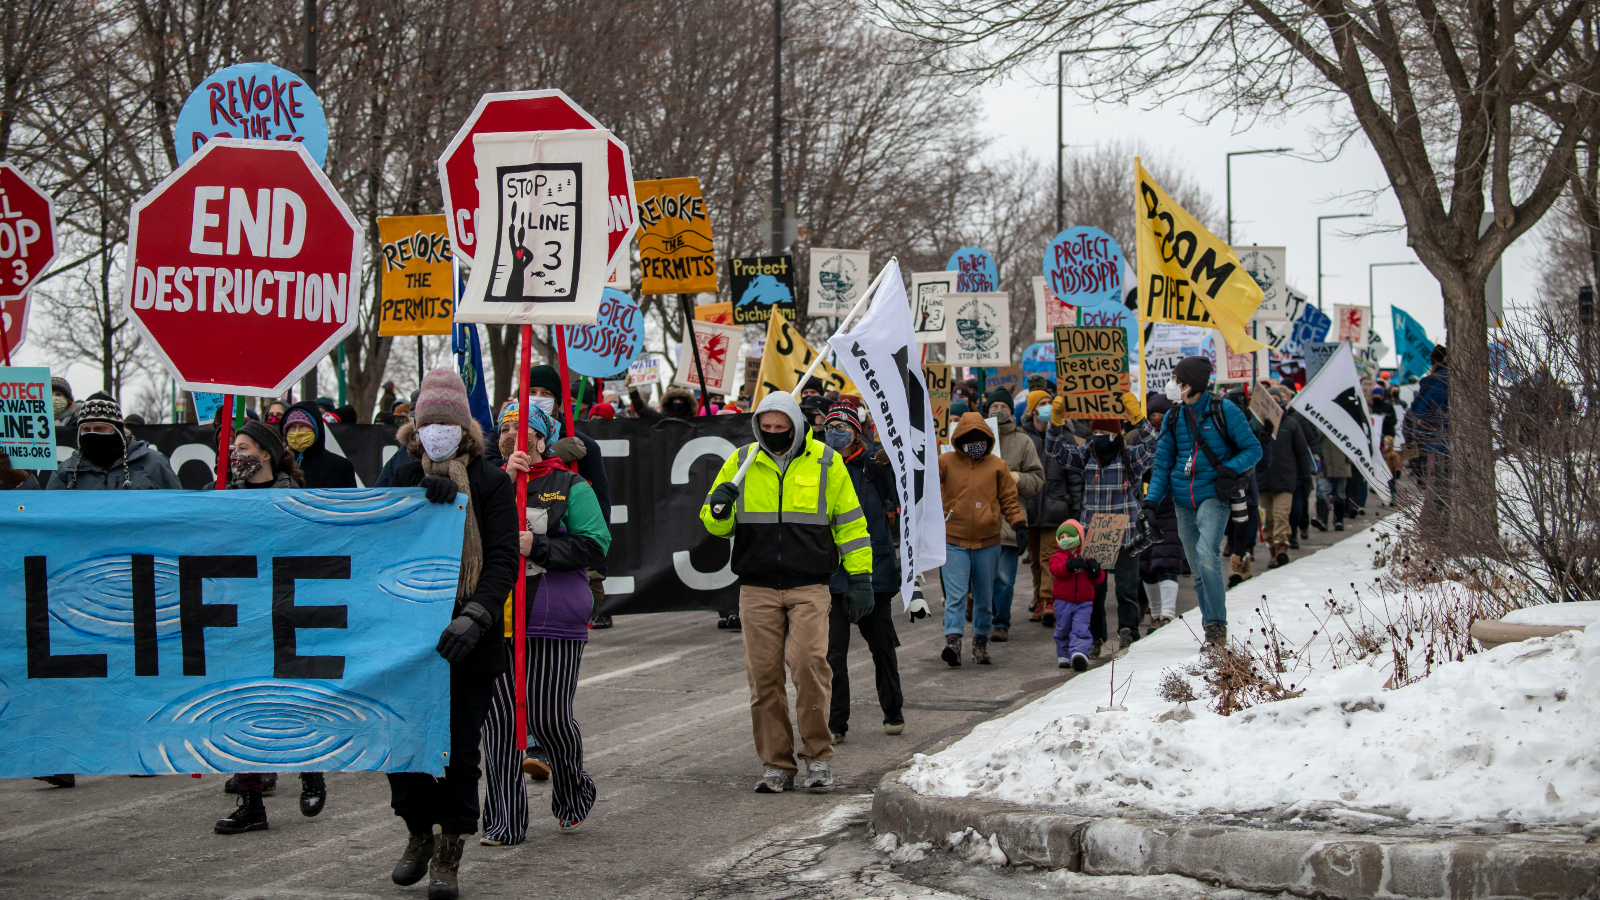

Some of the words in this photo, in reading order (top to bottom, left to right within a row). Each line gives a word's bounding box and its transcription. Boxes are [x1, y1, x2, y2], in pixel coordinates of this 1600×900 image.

[206, 75, 305, 134] REVOKE
[239, 113, 272, 141] THE
[507, 175, 547, 199] STOP
[190, 186, 307, 259] END
[528, 212, 570, 231] LINE
[637, 193, 706, 233] REVOKE
[382, 230, 453, 273] REVOKE
[662, 235, 684, 251] THE
[1053, 233, 1109, 270] PROTECT
[542, 241, 562, 270] 3
[641, 255, 715, 280] PERMITS
[733, 257, 788, 276] Protect
[957, 253, 987, 273] PROTECT
[11, 259, 29, 286] 3
[405, 272, 432, 288] THE
[133, 266, 347, 323] DESTRUCTION
[920, 285, 938, 296] STOP
[1147, 274, 1210, 324] PIPEL
[382, 296, 453, 321] PERMITS
[598, 298, 638, 333] OTECT
[932, 309, 941, 321] 3
[957, 300, 979, 316] PROTECT
[1271, 303, 1277, 311] 3
[1056, 329, 1125, 354] HONOR
[630, 358, 658, 370] WATER
[958, 352, 975, 360] STOP
[976, 352, 992, 360] LINE
[994, 352, 1000, 360] 3
[1056, 355, 1121, 376] Treaties
[1063, 373, 1119, 392] STOP
[7, 400, 47, 414] WATER
[38, 415, 50, 440] 3
[671, 436, 740, 591] 3
[1091, 516, 1113, 530] STOP
[1083, 543, 1118, 558] PROTECT
[24, 554, 352, 679] LIFE
